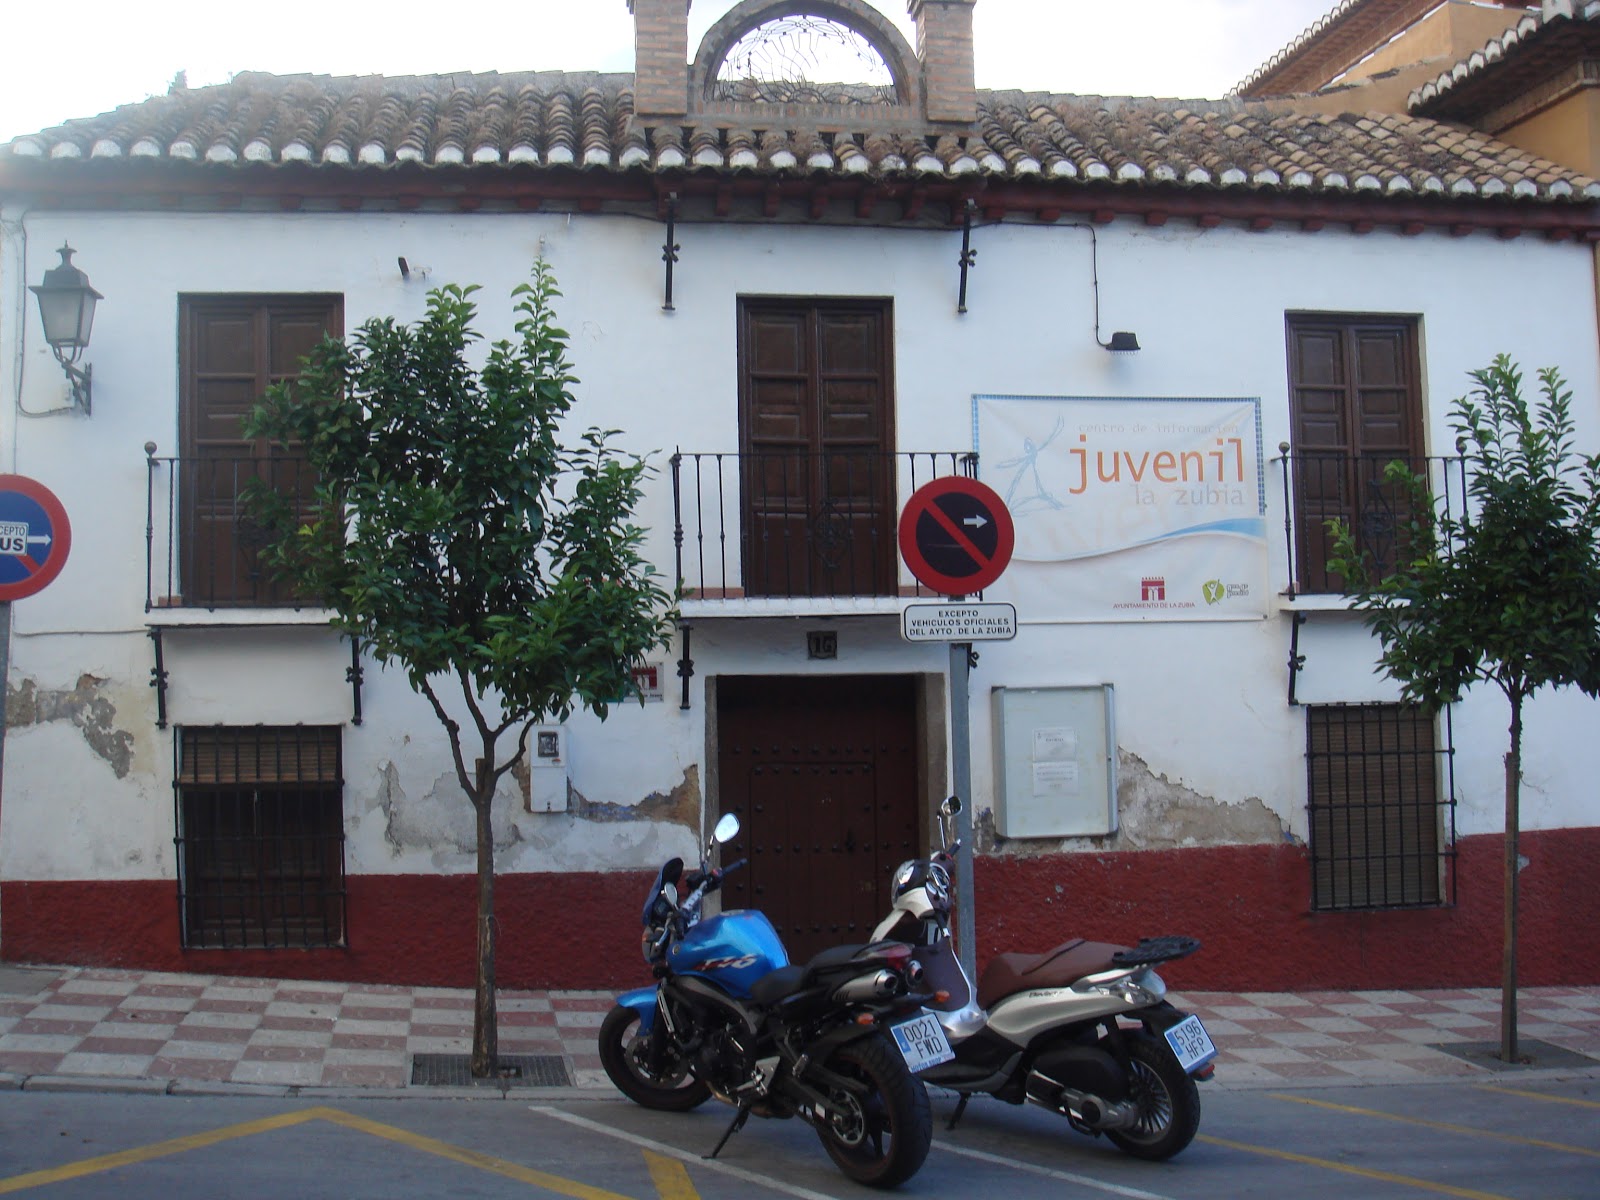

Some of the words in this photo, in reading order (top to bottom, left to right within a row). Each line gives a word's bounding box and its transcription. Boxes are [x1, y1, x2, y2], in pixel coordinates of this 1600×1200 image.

[1078, 423, 1125, 434] centro
[1132, 422, 1147, 434] de
[1069, 434, 1243, 494] juvenil
[1130, 484, 1155, 506] la
[1175, 484, 1244, 506] zubia
[911, 619, 961, 627] VEHICULOS
[964, 618, 1009, 626] OFICIALES
[938, 610, 979, 618] EXCEPTO
[909, 628, 926, 636] DEL
[958, 627, 969, 635] DE
[972, 626, 984, 634] LA
[986, 625, 1012, 634] ZUBIA
[903, 1019, 937, 1043] 0021
[1174, 1021, 1202, 1045] 5196
[915, 1036, 943, 1059] FWD
[1185, 1037, 1205, 1060] HFP
